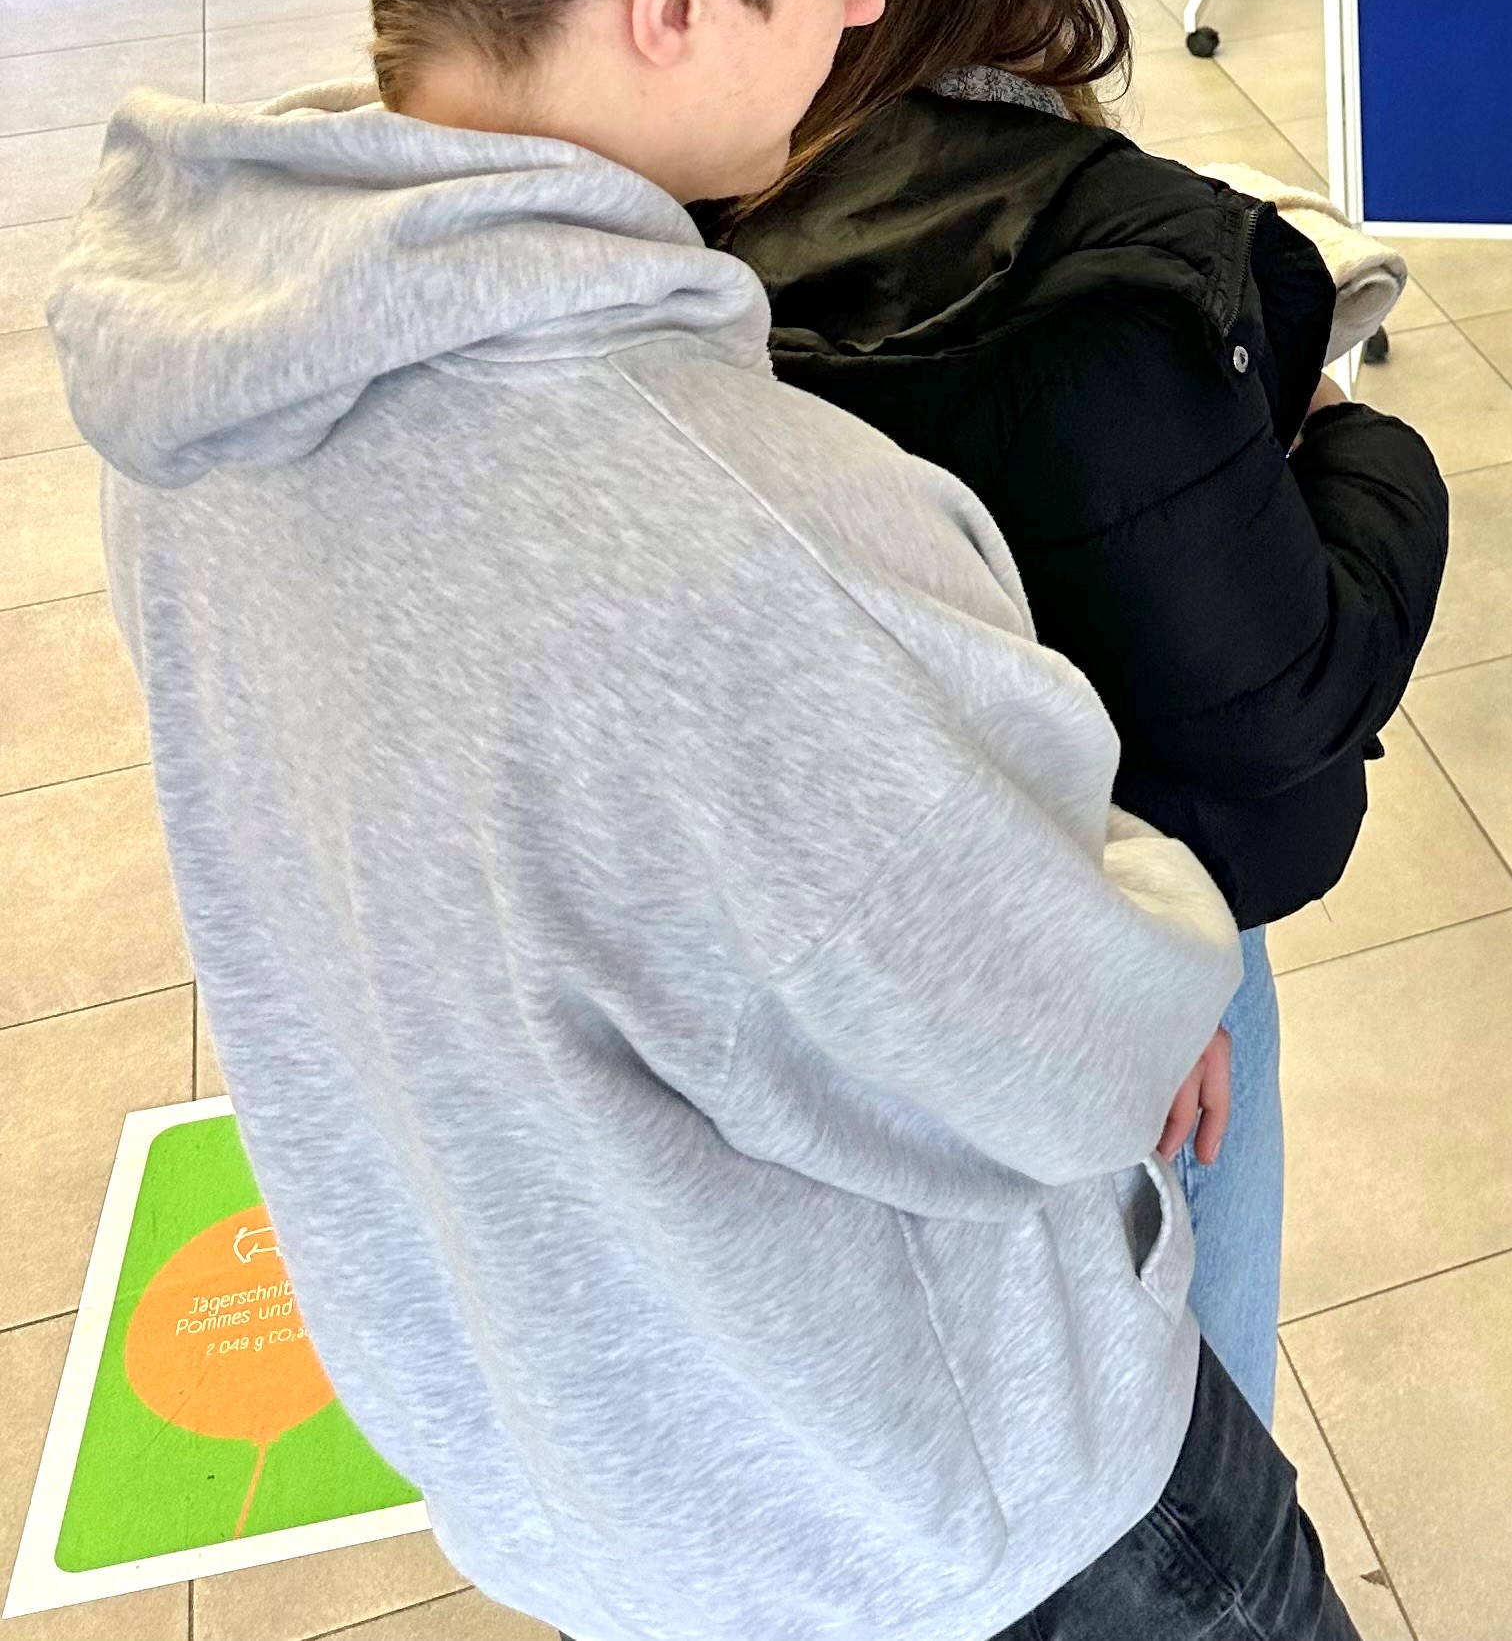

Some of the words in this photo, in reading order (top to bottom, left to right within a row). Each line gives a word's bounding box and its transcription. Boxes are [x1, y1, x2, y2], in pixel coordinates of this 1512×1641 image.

[175, 1309, 252, 1336] Pommes
[258, 1297, 294, 1321] und
[188, 1279, 296, 1318] Jägerschnit
[205, 1342, 217, 1357] 2
[219, 1336, 251, 1355] 049
[253, 1336, 264, 1353] g
